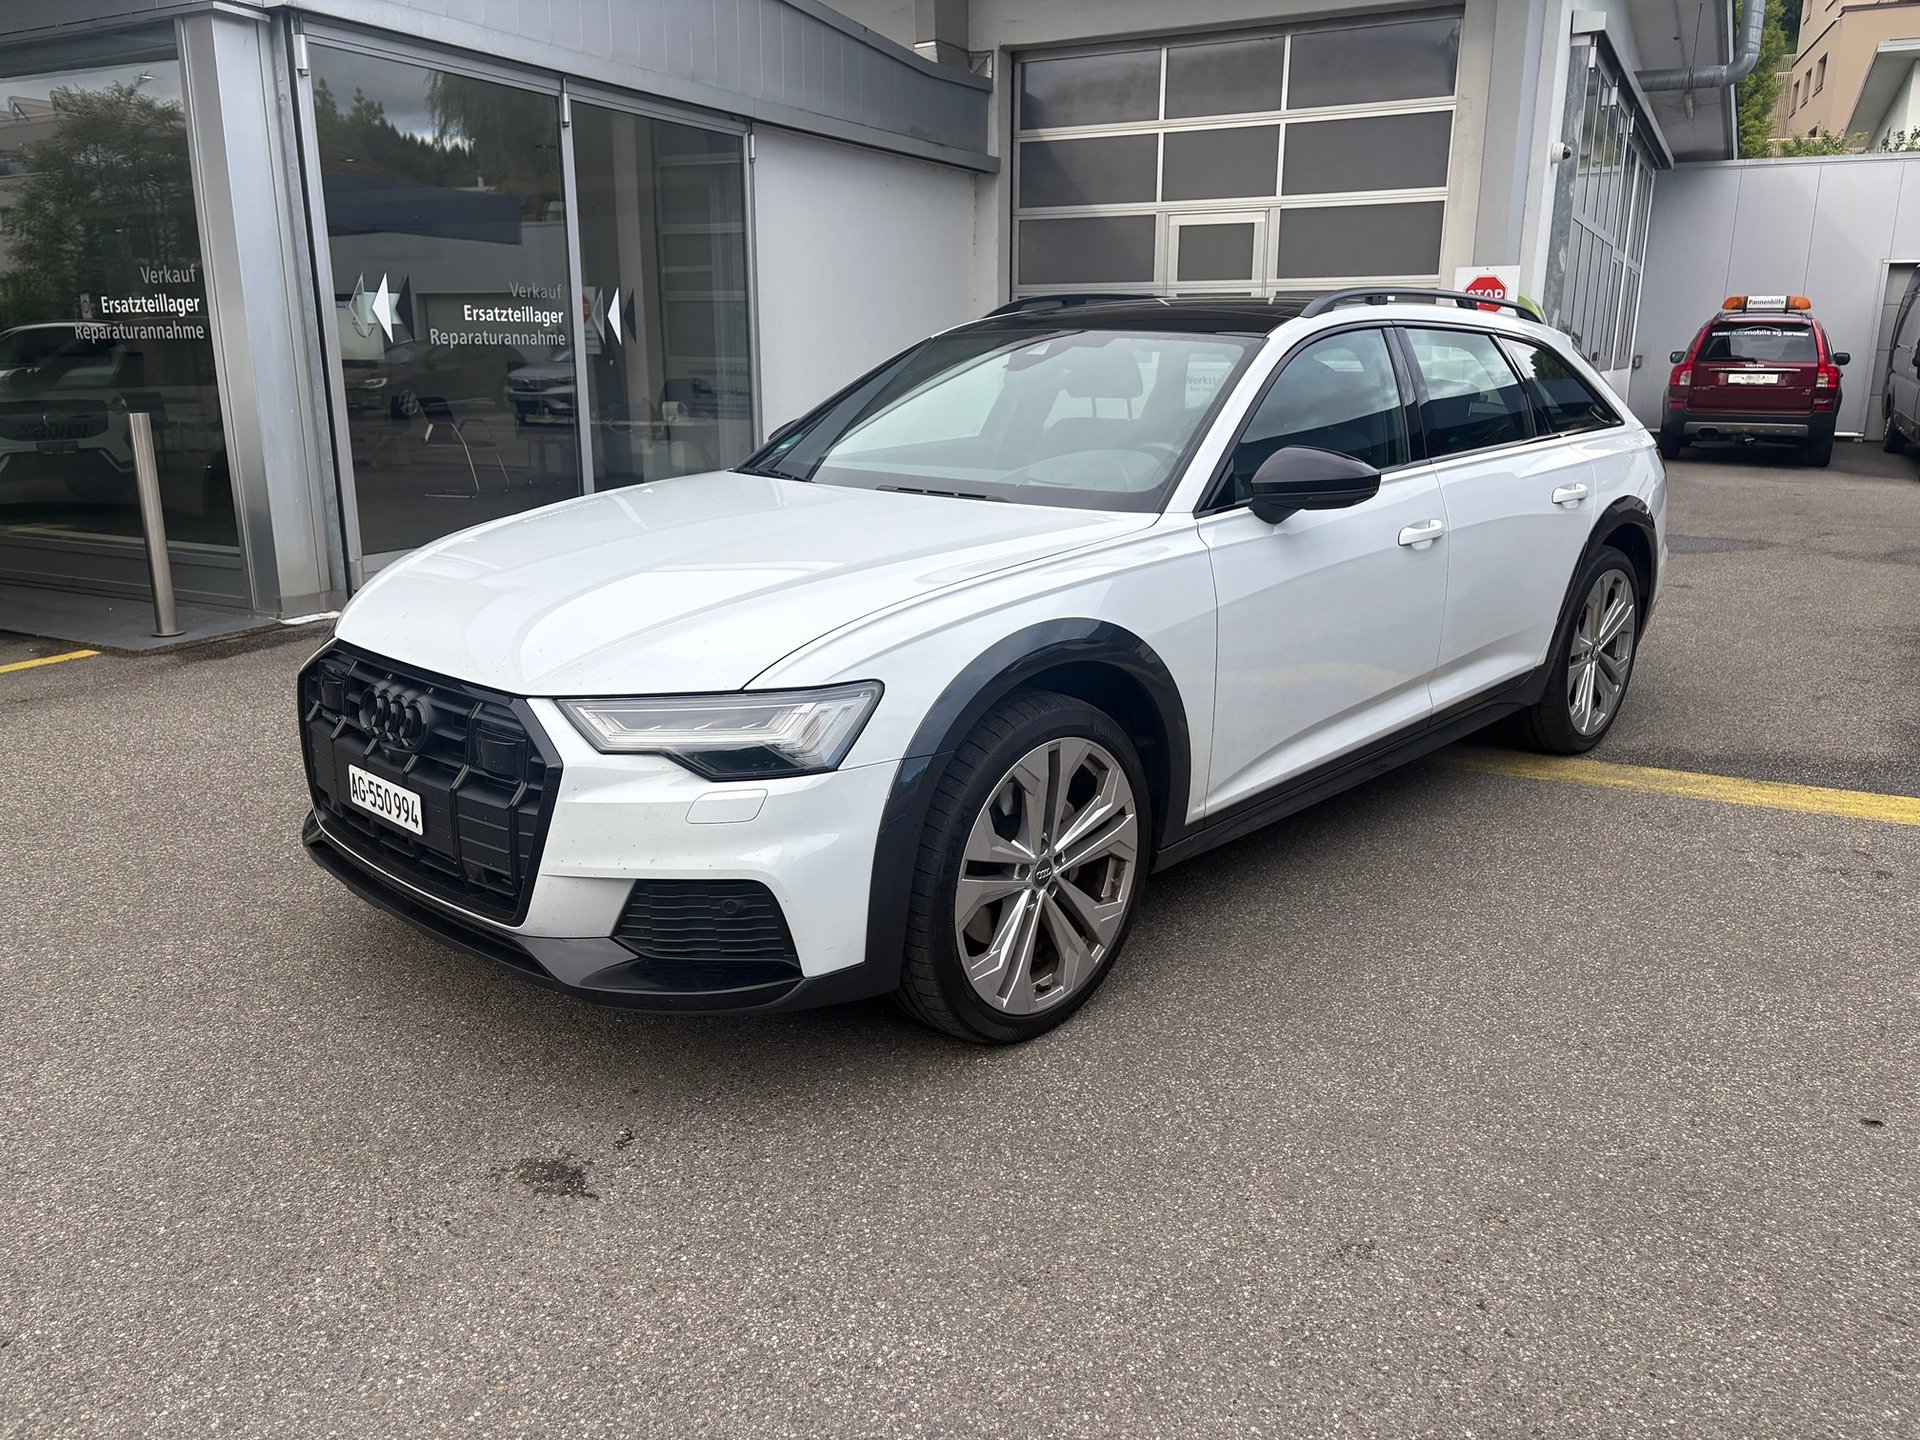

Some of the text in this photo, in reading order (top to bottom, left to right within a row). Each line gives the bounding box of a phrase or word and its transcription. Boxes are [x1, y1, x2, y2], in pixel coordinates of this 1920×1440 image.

[140, 264, 196, 284] Verkauf
[509, 281, 562, 299] Verkauf
[101, 293, 200, 317] Ersatzteillager
[463, 304, 563, 327] Ersatzteillager
[74, 320, 205, 344] Reparaturannahme
[429, 328, 566, 348] Reparaturannahme
